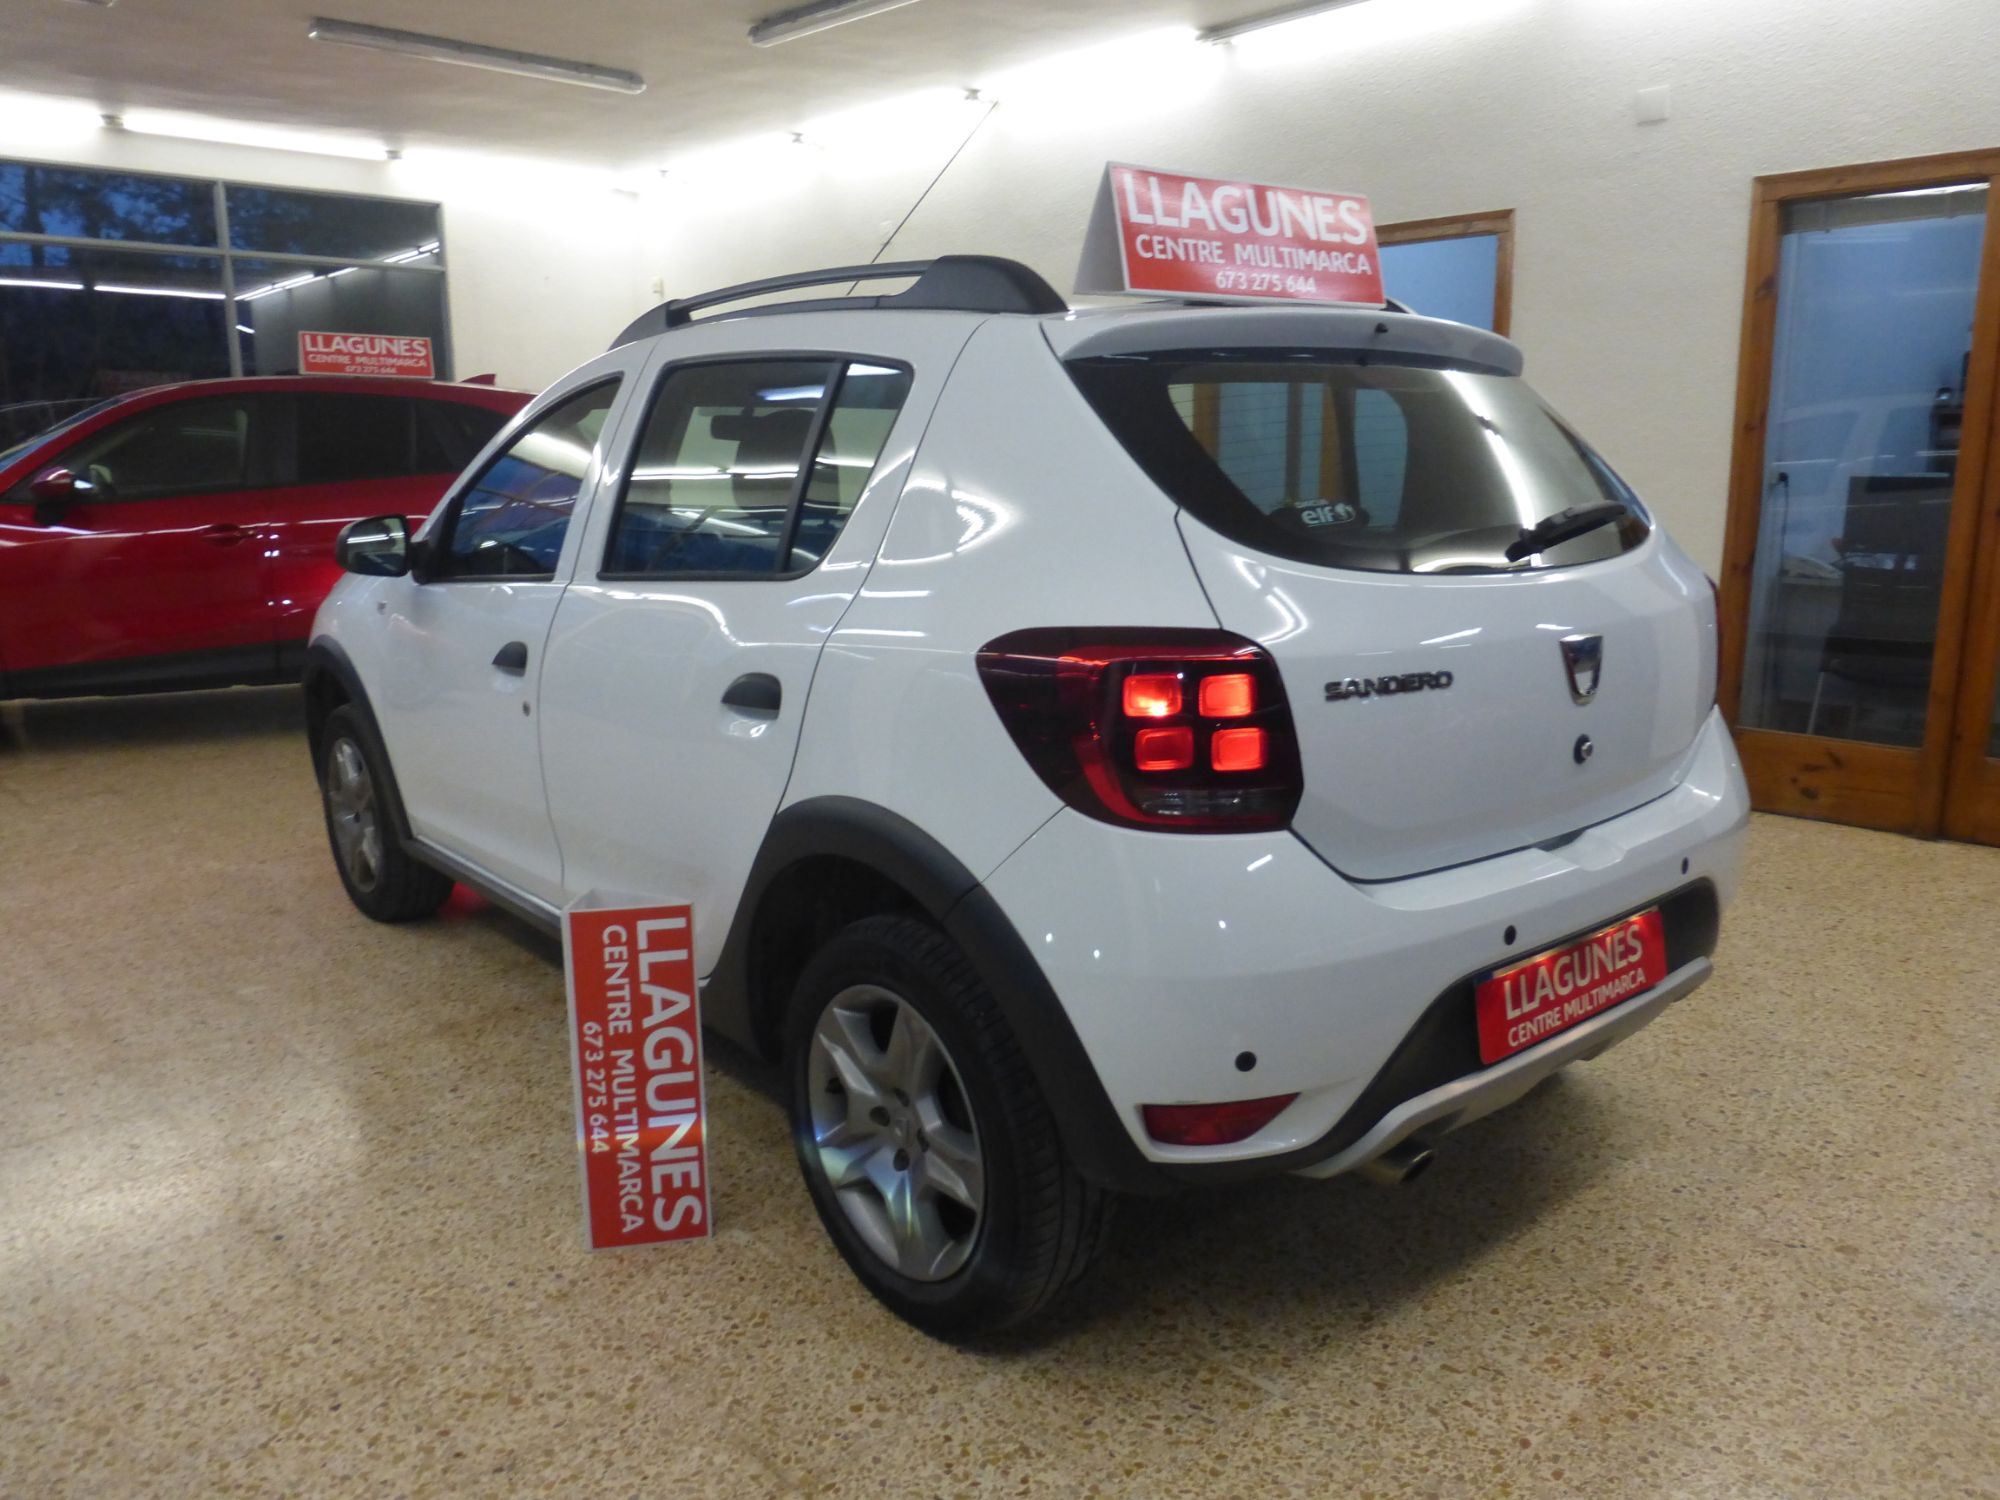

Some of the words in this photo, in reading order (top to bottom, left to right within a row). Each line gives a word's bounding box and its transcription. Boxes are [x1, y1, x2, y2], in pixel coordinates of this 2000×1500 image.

[1122, 172, 1368, 246] LLAGUNES
[1136, 234, 1225, 264] CENTRE
[1235, 244, 1372, 275] MULTIMARCA
[1216, 271, 1248, 290] 673
[1250, 273, 1282, 292] 275
[1286, 275, 1317, 293] 644
[304, 334, 427, 357] LLAGUNES
[308, 353, 351, 365] CENTRE
[355, 356, 427, 368] MULTIMARCA
[1301, 506, 1335, 525] elf
[1325, 670, 1455, 701] SANDERO
[602, 924, 633, 1036] CENTRE
[1503, 924, 1643, 1020] LLAGUNES
[1508, 1012, 1562, 1048] CENTRE
[1564, 968, 1646, 1022] MULTIMARCA
[583, 1021, 603, 1063] 673
[586, 1067, 608, 1107] 275
[636, 917, 703, 1232] LLAGUNES
[589, 1113, 611, 1153] 644
[610, 1048, 645, 1234] MULTIMARCA
